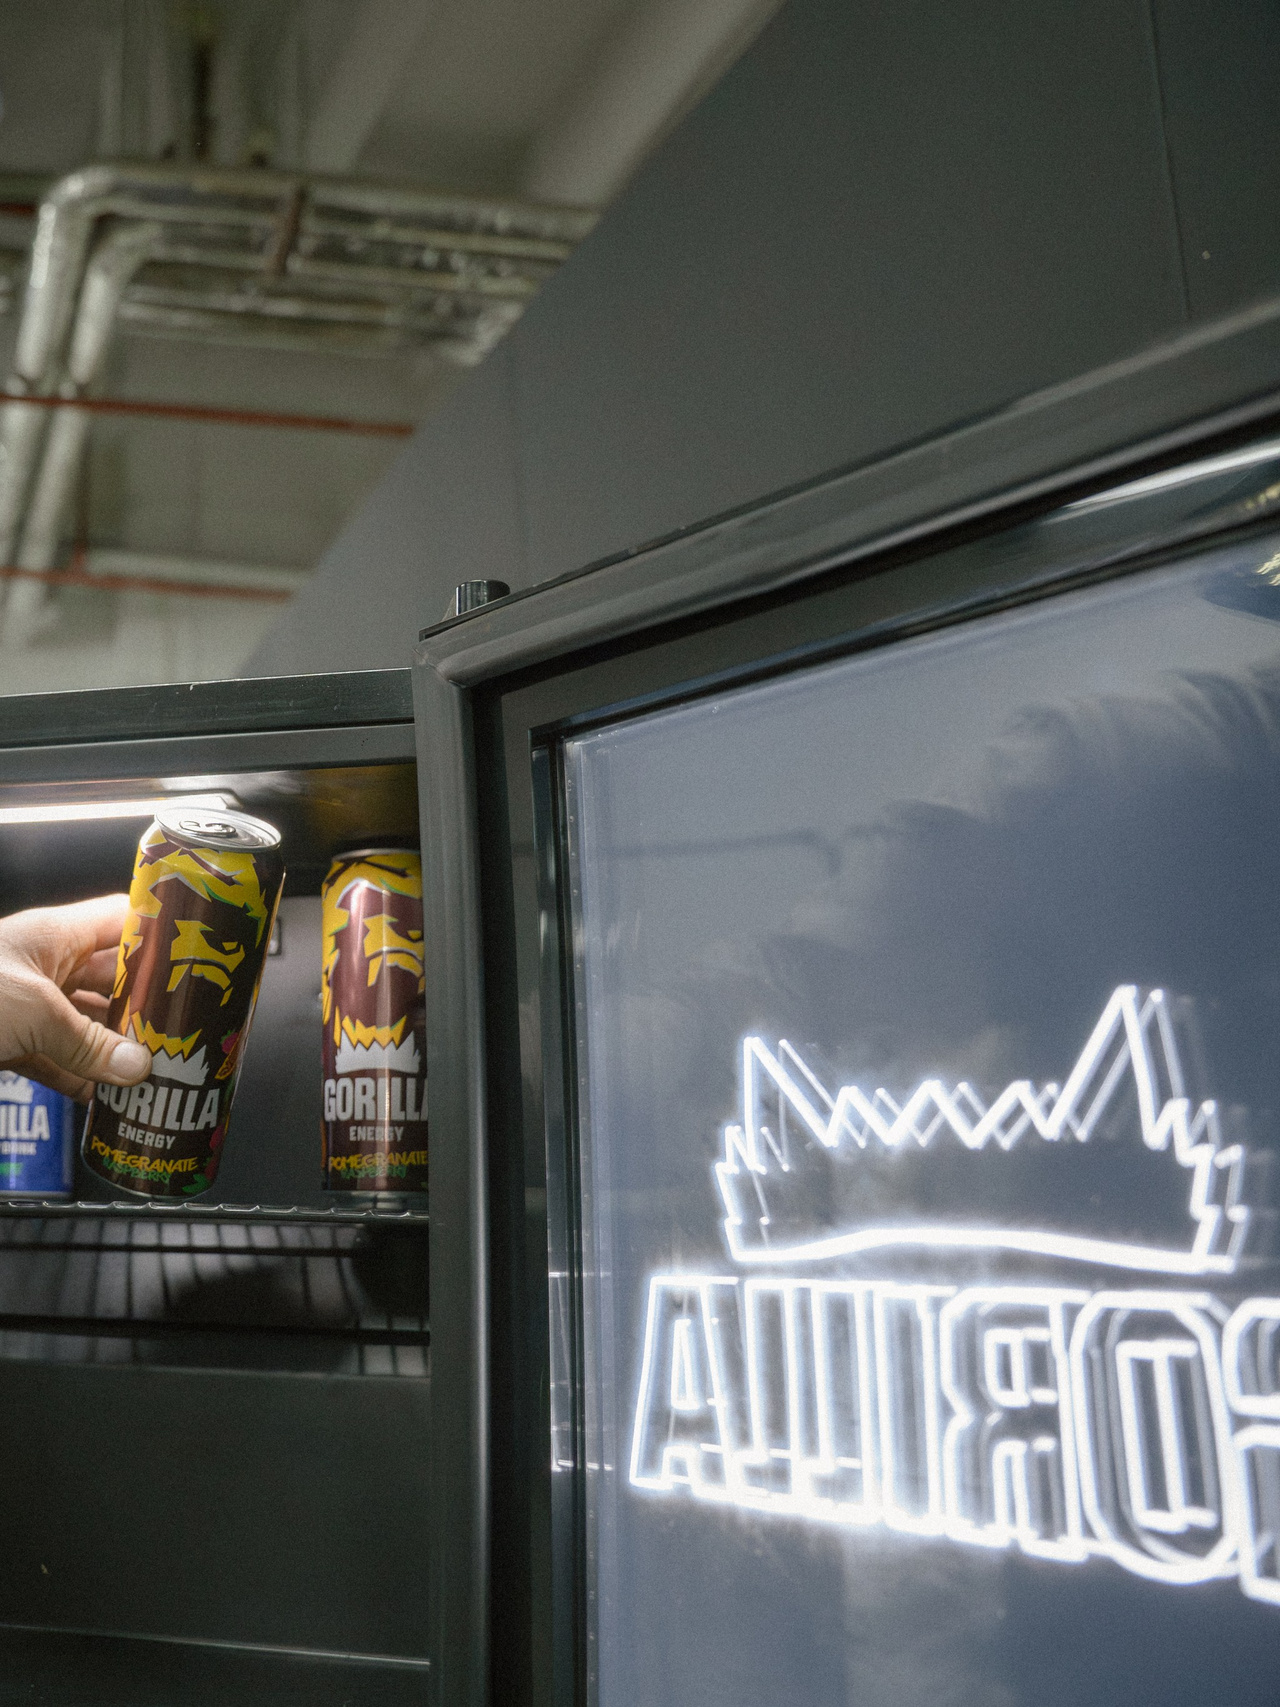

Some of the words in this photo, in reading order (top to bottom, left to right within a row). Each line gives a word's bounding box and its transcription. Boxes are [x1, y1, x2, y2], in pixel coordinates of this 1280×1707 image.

[118, 1121, 176, 1150] ENERGY
[349, 1125, 404, 1142] ENERGY
[91, 1136, 198, 1173] POMEGRANATE
[102, 1156, 171, 1184] RASPBERRY
